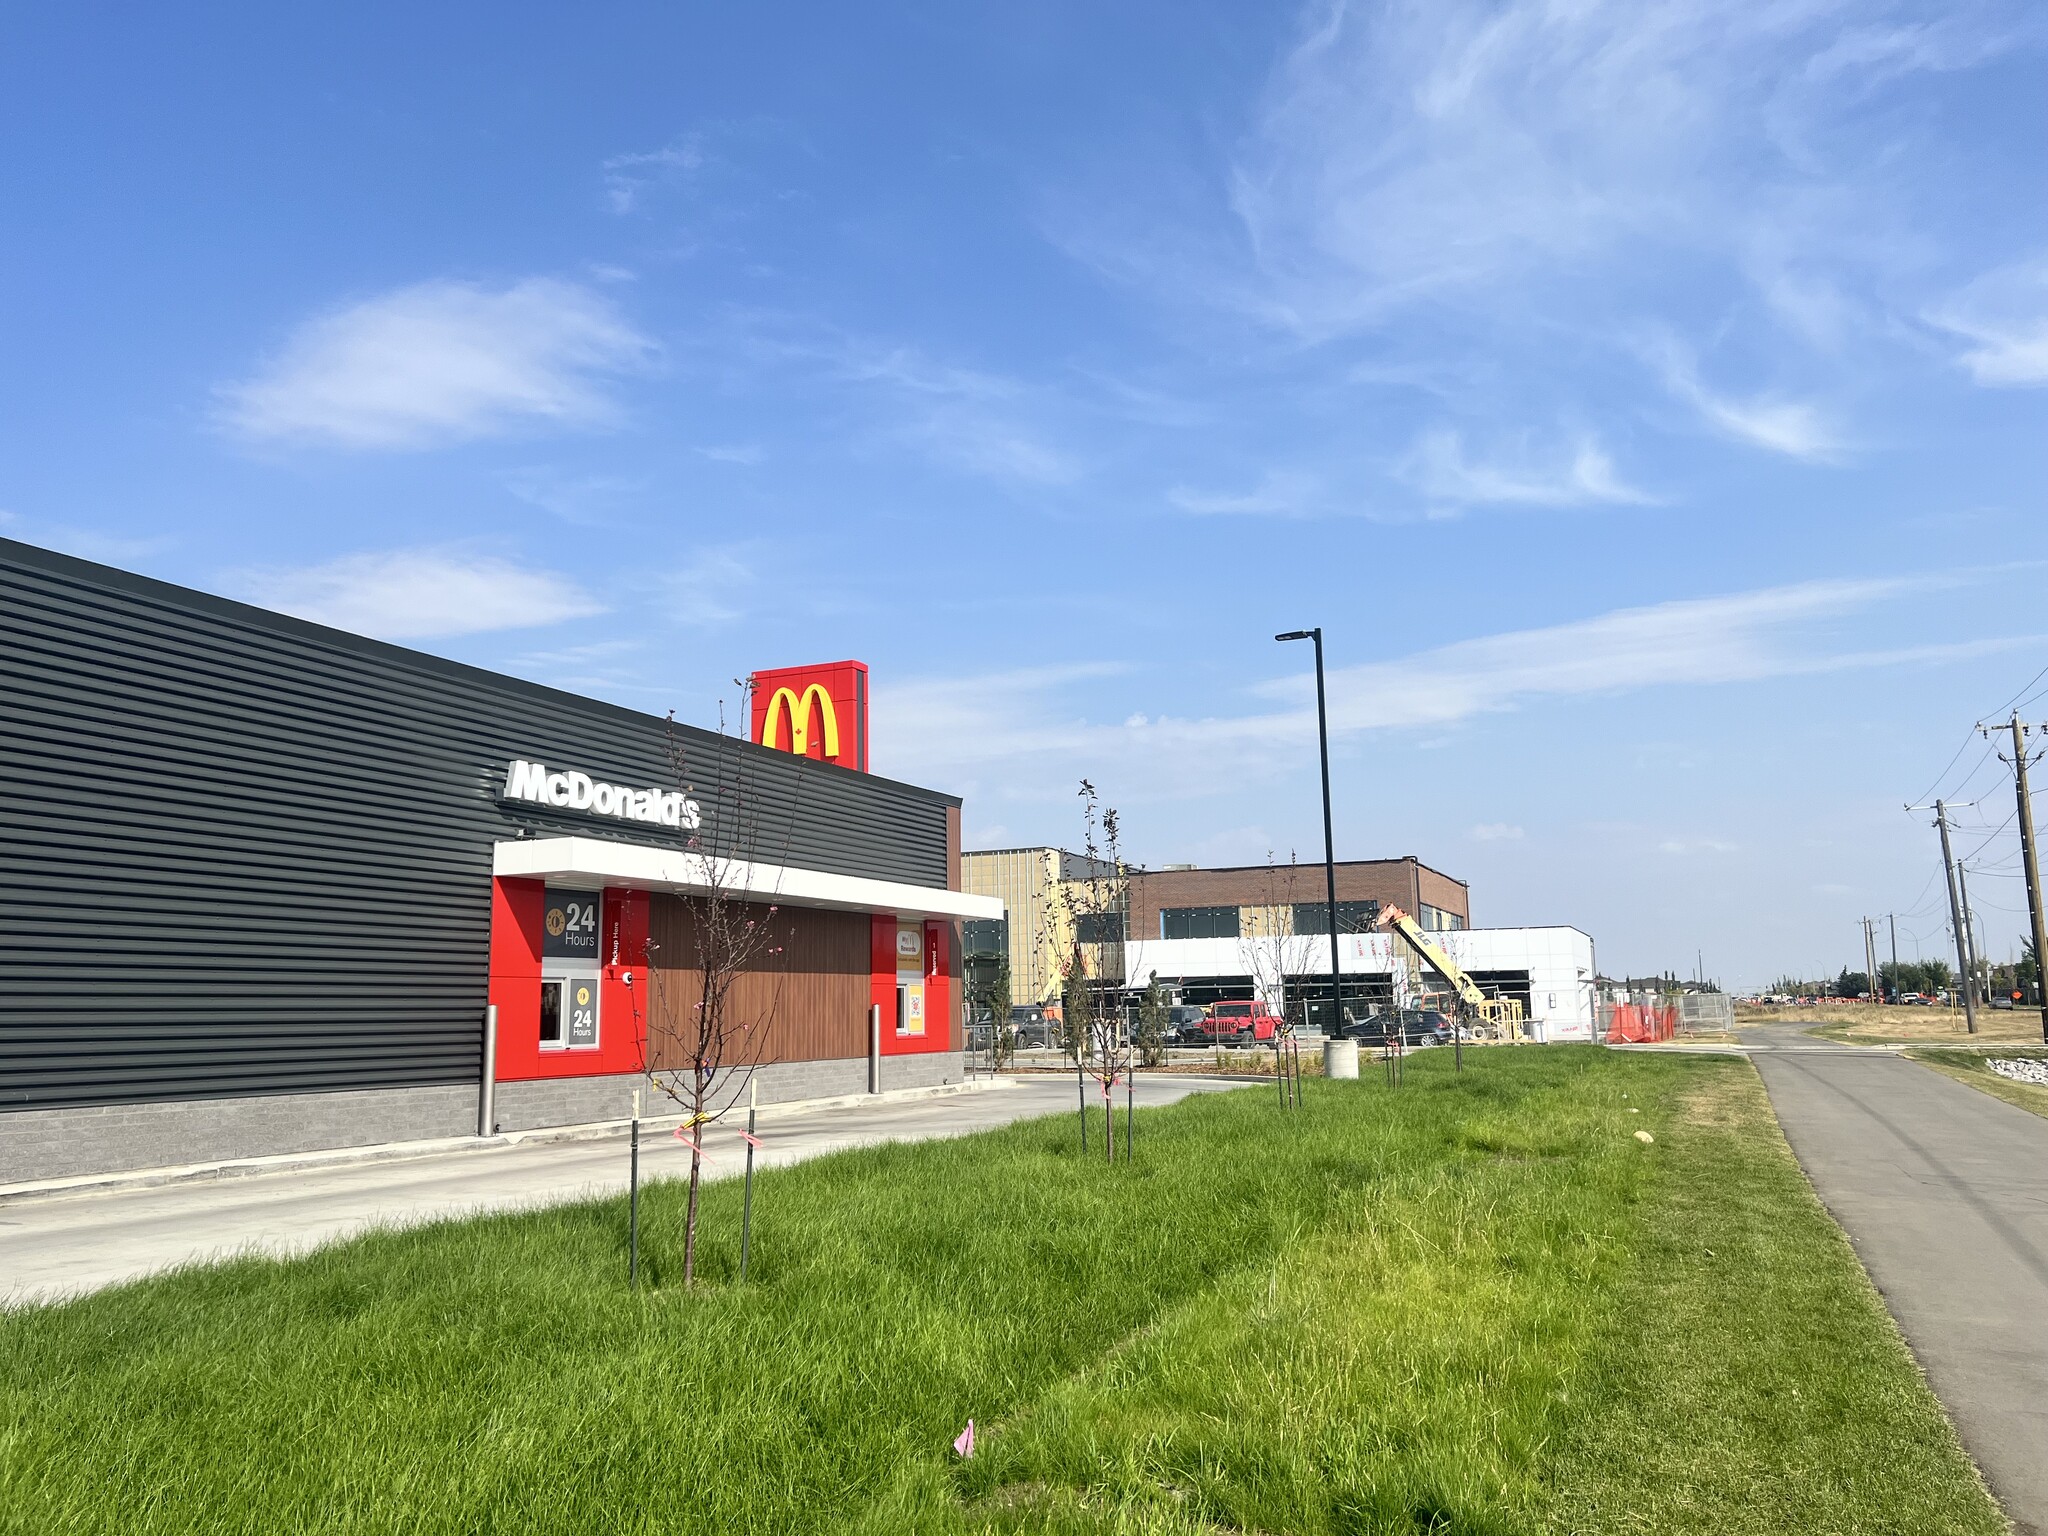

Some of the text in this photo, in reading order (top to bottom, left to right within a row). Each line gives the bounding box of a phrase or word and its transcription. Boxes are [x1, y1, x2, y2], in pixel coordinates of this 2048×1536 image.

[504, 759, 700, 829] McDonald's
[566, 903, 595, 932] 24
[565, 932, 595, 947] Hours
[1413, 931, 1431, 946] JLG
[573, 1010, 592, 1028] 24
[573, 1028, 591, 1037] Hours
